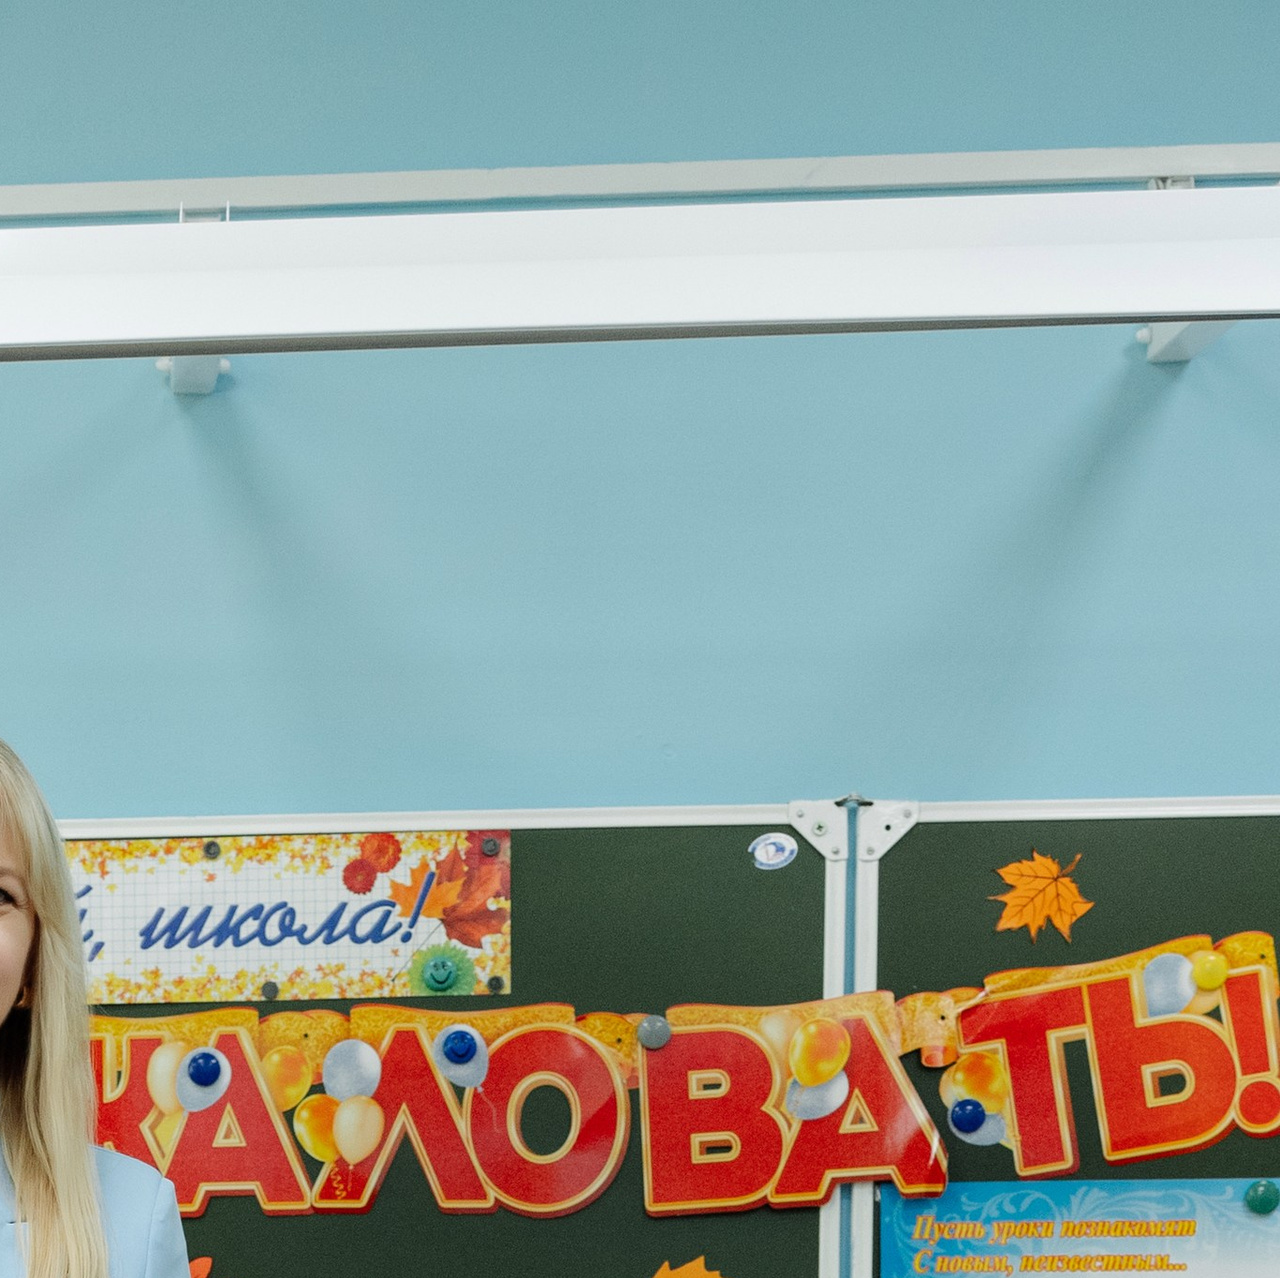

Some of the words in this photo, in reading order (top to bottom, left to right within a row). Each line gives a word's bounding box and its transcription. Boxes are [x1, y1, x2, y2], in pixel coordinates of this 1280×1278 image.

[139, 871, 436, 950] школа!
[911, 1215, 985, 1246] Пусть
[988, 1220, 1054, 1245] уроки
[1059, 1219, 1197, 1239] познакомят
[913, 1249, 933, 1274] С
[935, 1254, 1014, 1277] новым,
